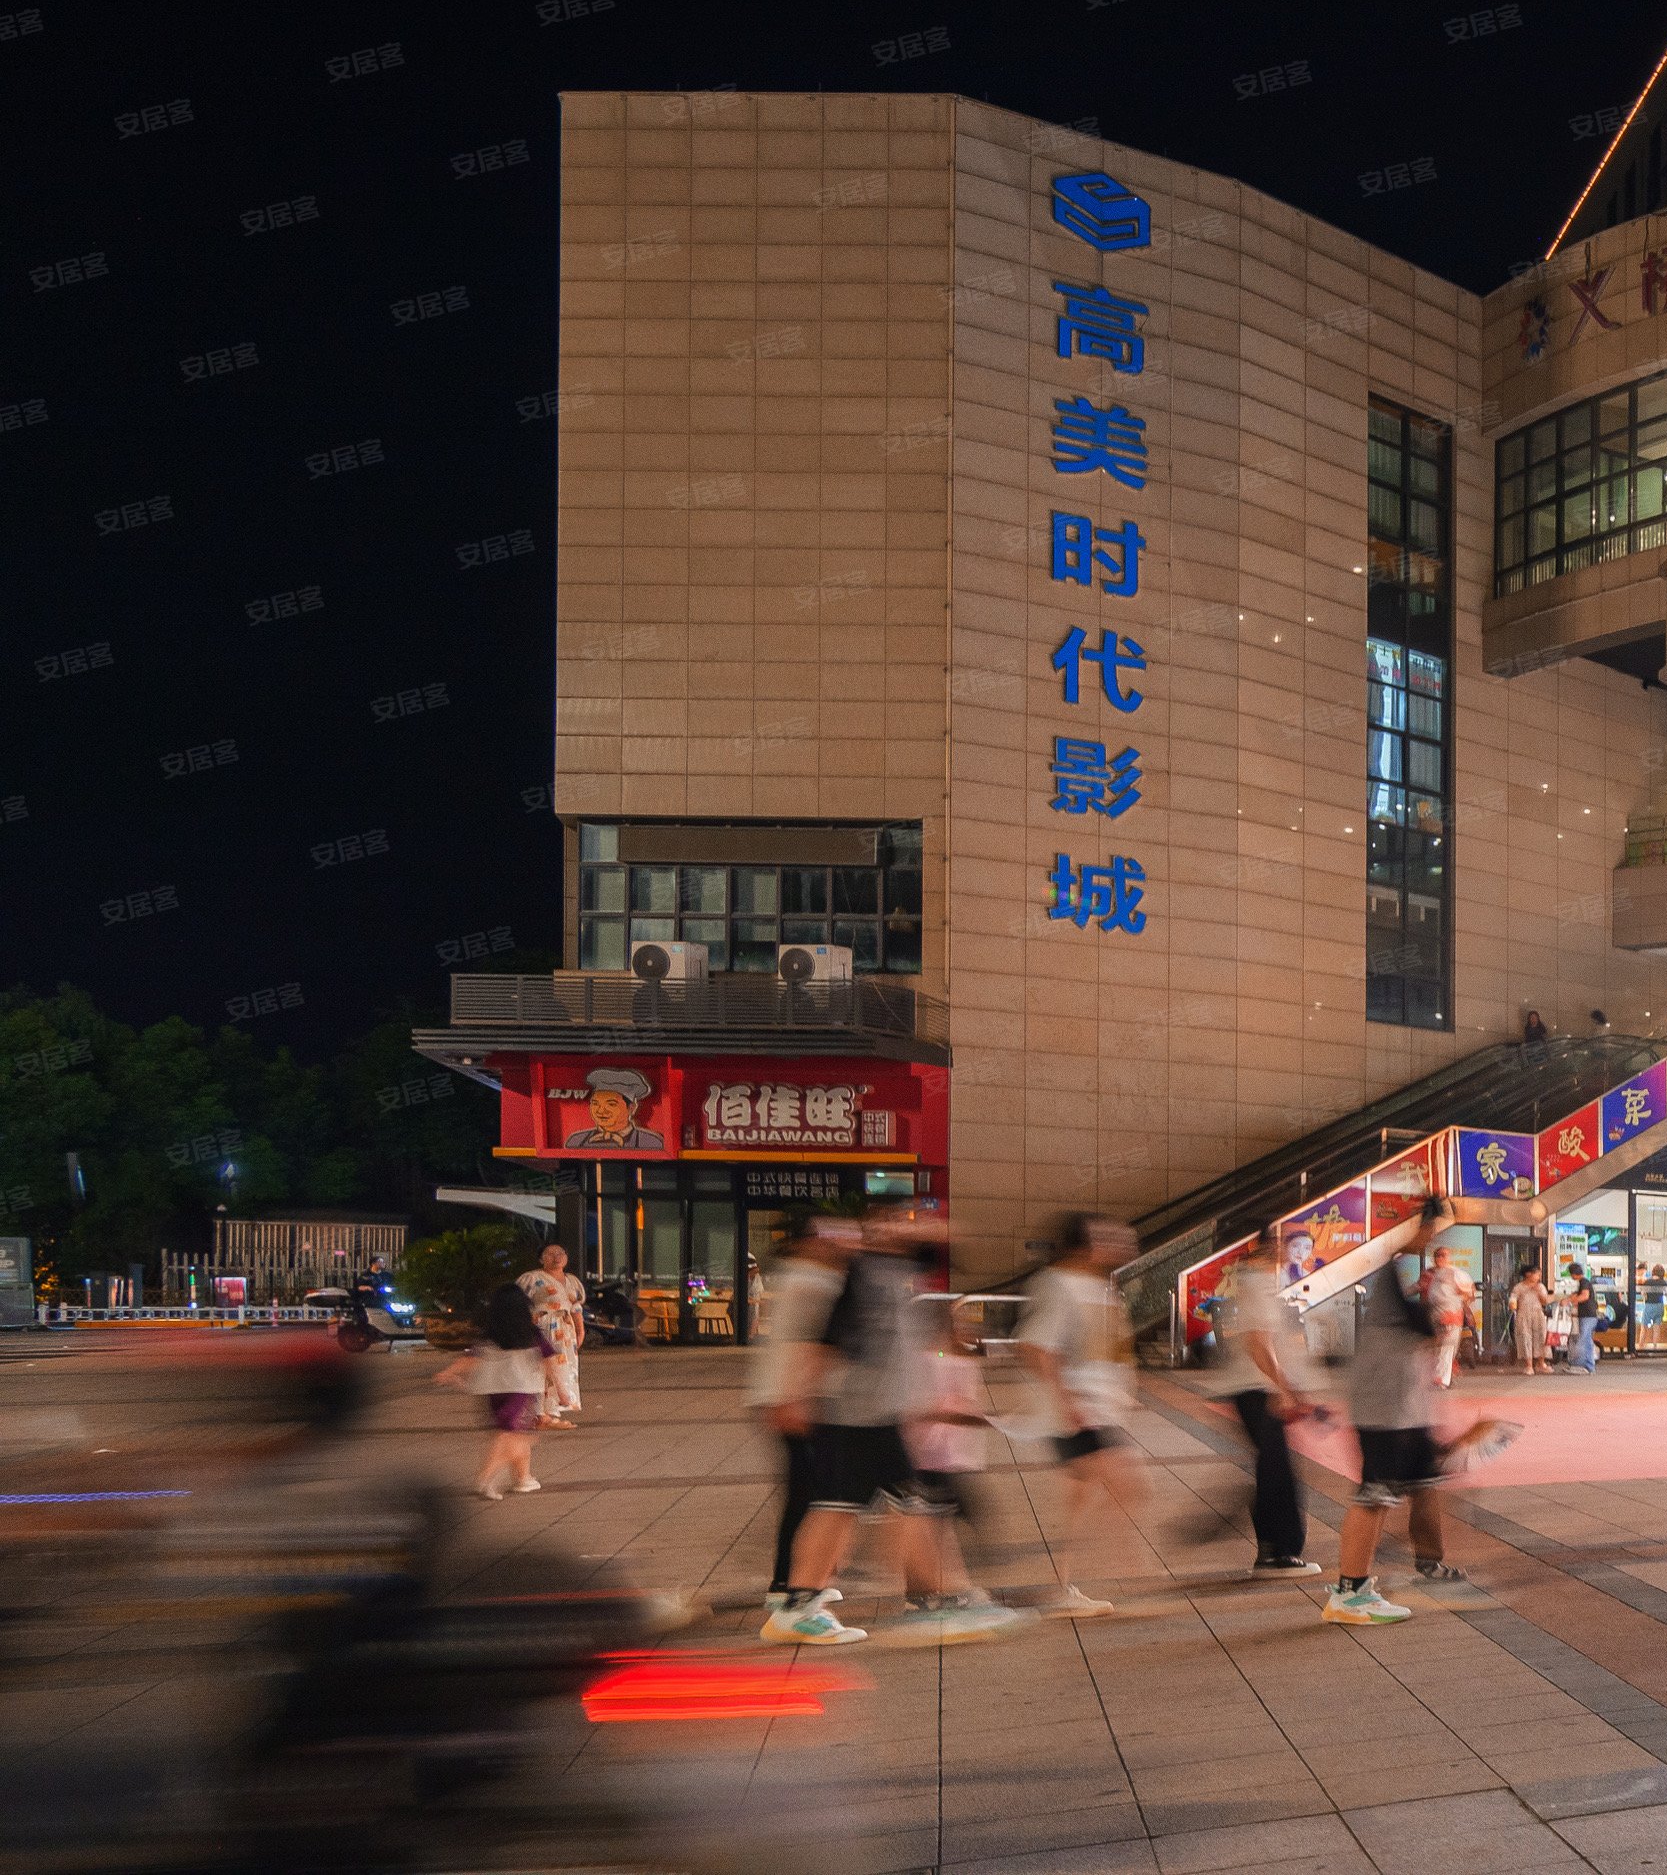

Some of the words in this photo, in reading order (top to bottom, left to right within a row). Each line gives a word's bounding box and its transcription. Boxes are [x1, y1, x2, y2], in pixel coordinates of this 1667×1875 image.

[1050, 280, 1149, 937] 高美时代影城
[548, 1088, 590, 1100] BJW
[705, 1083, 856, 1128] 佰佳旺
[706, 1128, 853, 1145] BAIJIAWANG
